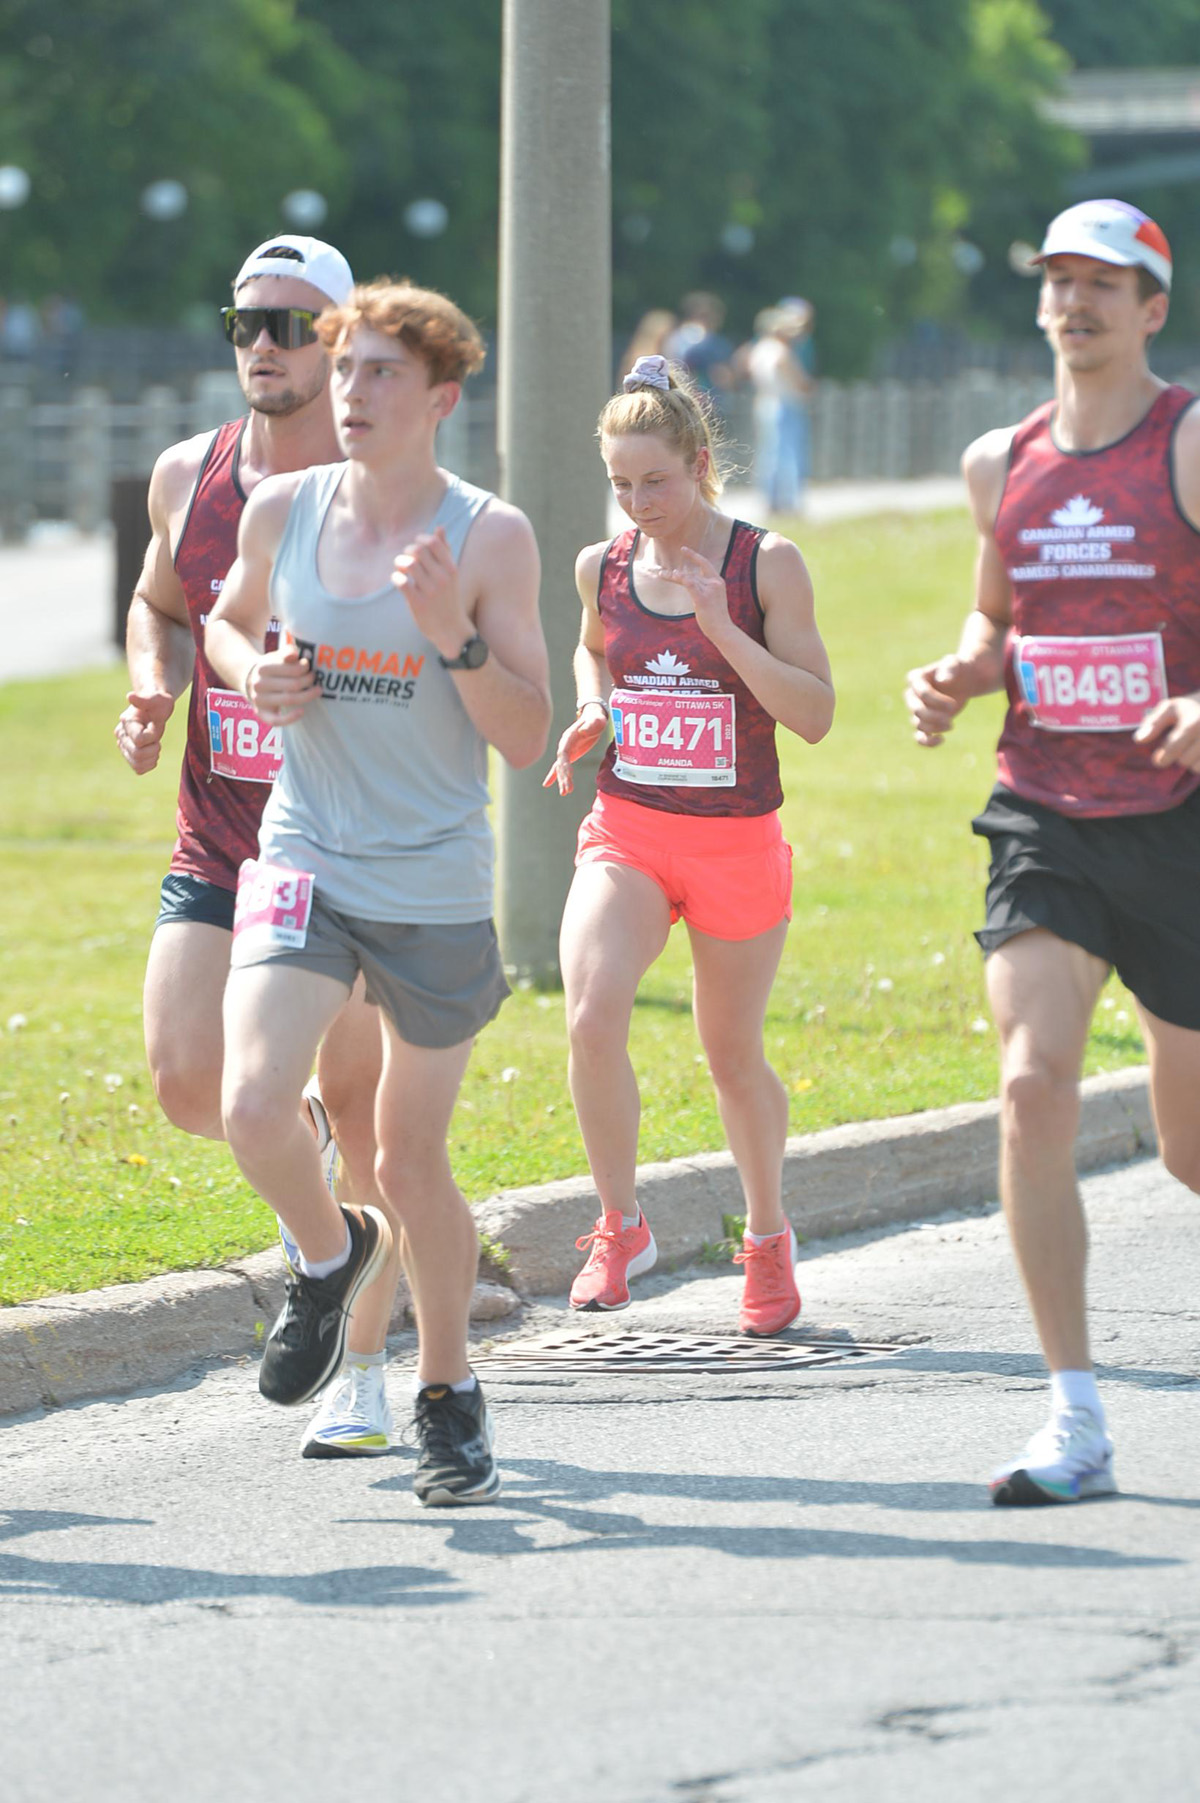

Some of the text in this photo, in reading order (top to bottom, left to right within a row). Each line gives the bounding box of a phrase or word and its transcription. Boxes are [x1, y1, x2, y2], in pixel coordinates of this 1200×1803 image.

[1020, 526, 1135, 542] CANADIAN ARMED
[1041, 543, 1112, 561] FORCES
[1061, 563, 1156, 579] CANADIENNES
[317, 644, 425, 678] ROMAN
[313, 670, 416, 700] RUNNERS
[679, 677, 720, 689] ARMED
[1038, 662, 1151, 706] 18436
[675, 700, 725, 710] OTTAWA 5K
[624, 713, 723, 751] 18471
[657, 757, 693, 767] AMANDA
